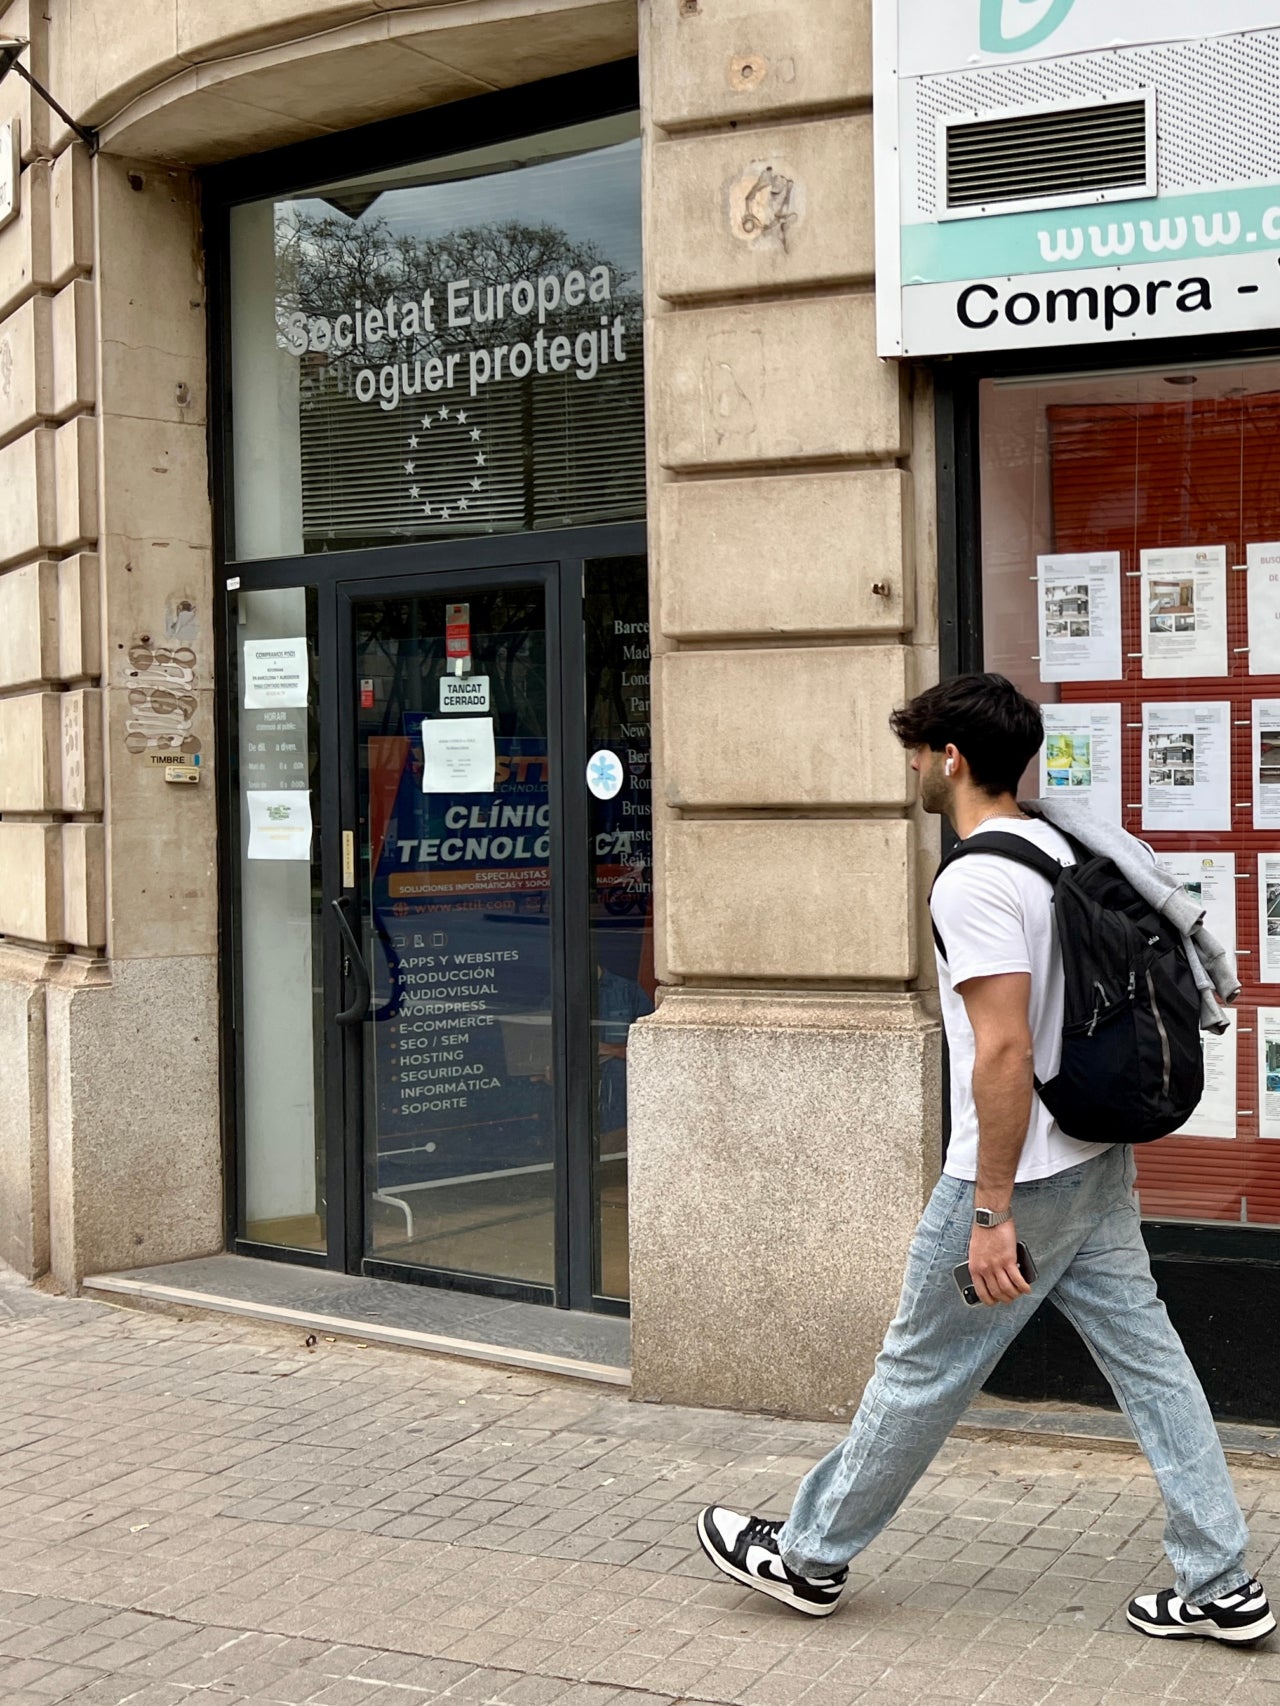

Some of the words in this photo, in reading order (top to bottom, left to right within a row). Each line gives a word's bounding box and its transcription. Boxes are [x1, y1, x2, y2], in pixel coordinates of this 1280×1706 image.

[287, 288, 435, 356] Societat
[448, 265, 611, 327] Europea
[956, 275, 1212, 331] Compra
[469, 315, 626, 396] protegit
[1269, 573, 1280, 582] DE
[448, 684, 482, 693] TANCAT
[444, 696, 486, 706] CERRADO
[151, 755, 185, 764] TIMBRE
[475, 869, 547, 884] ESPECIALISTAS
[399, 881, 453, 894] SOLUCIONES
[398, 956, 435, 969] APPS
[439, 955, 449, 966] Y
[453, 950, 519, 965] WEBSITES
[398, 966, 495, 985] PRODUCCIÓN
[398, 983, 498, 1001] AUDIOVISUAL
[399, 1000, 487, 1017] WORDPRESS
[400, 1015, 494, 1034] E-COMMERCE
[400, 1037, 428, 1050] SEO
[441, 1033, 469, 1046] SEM
[400, 1050, 464, 1066] HOSTING
[400, 1064, 484, 1083] SEGURIDAD
[401, 1077, 501, 1099] INFORMÁTICA
[401, 1097, 468, 1115] SOPORTE
